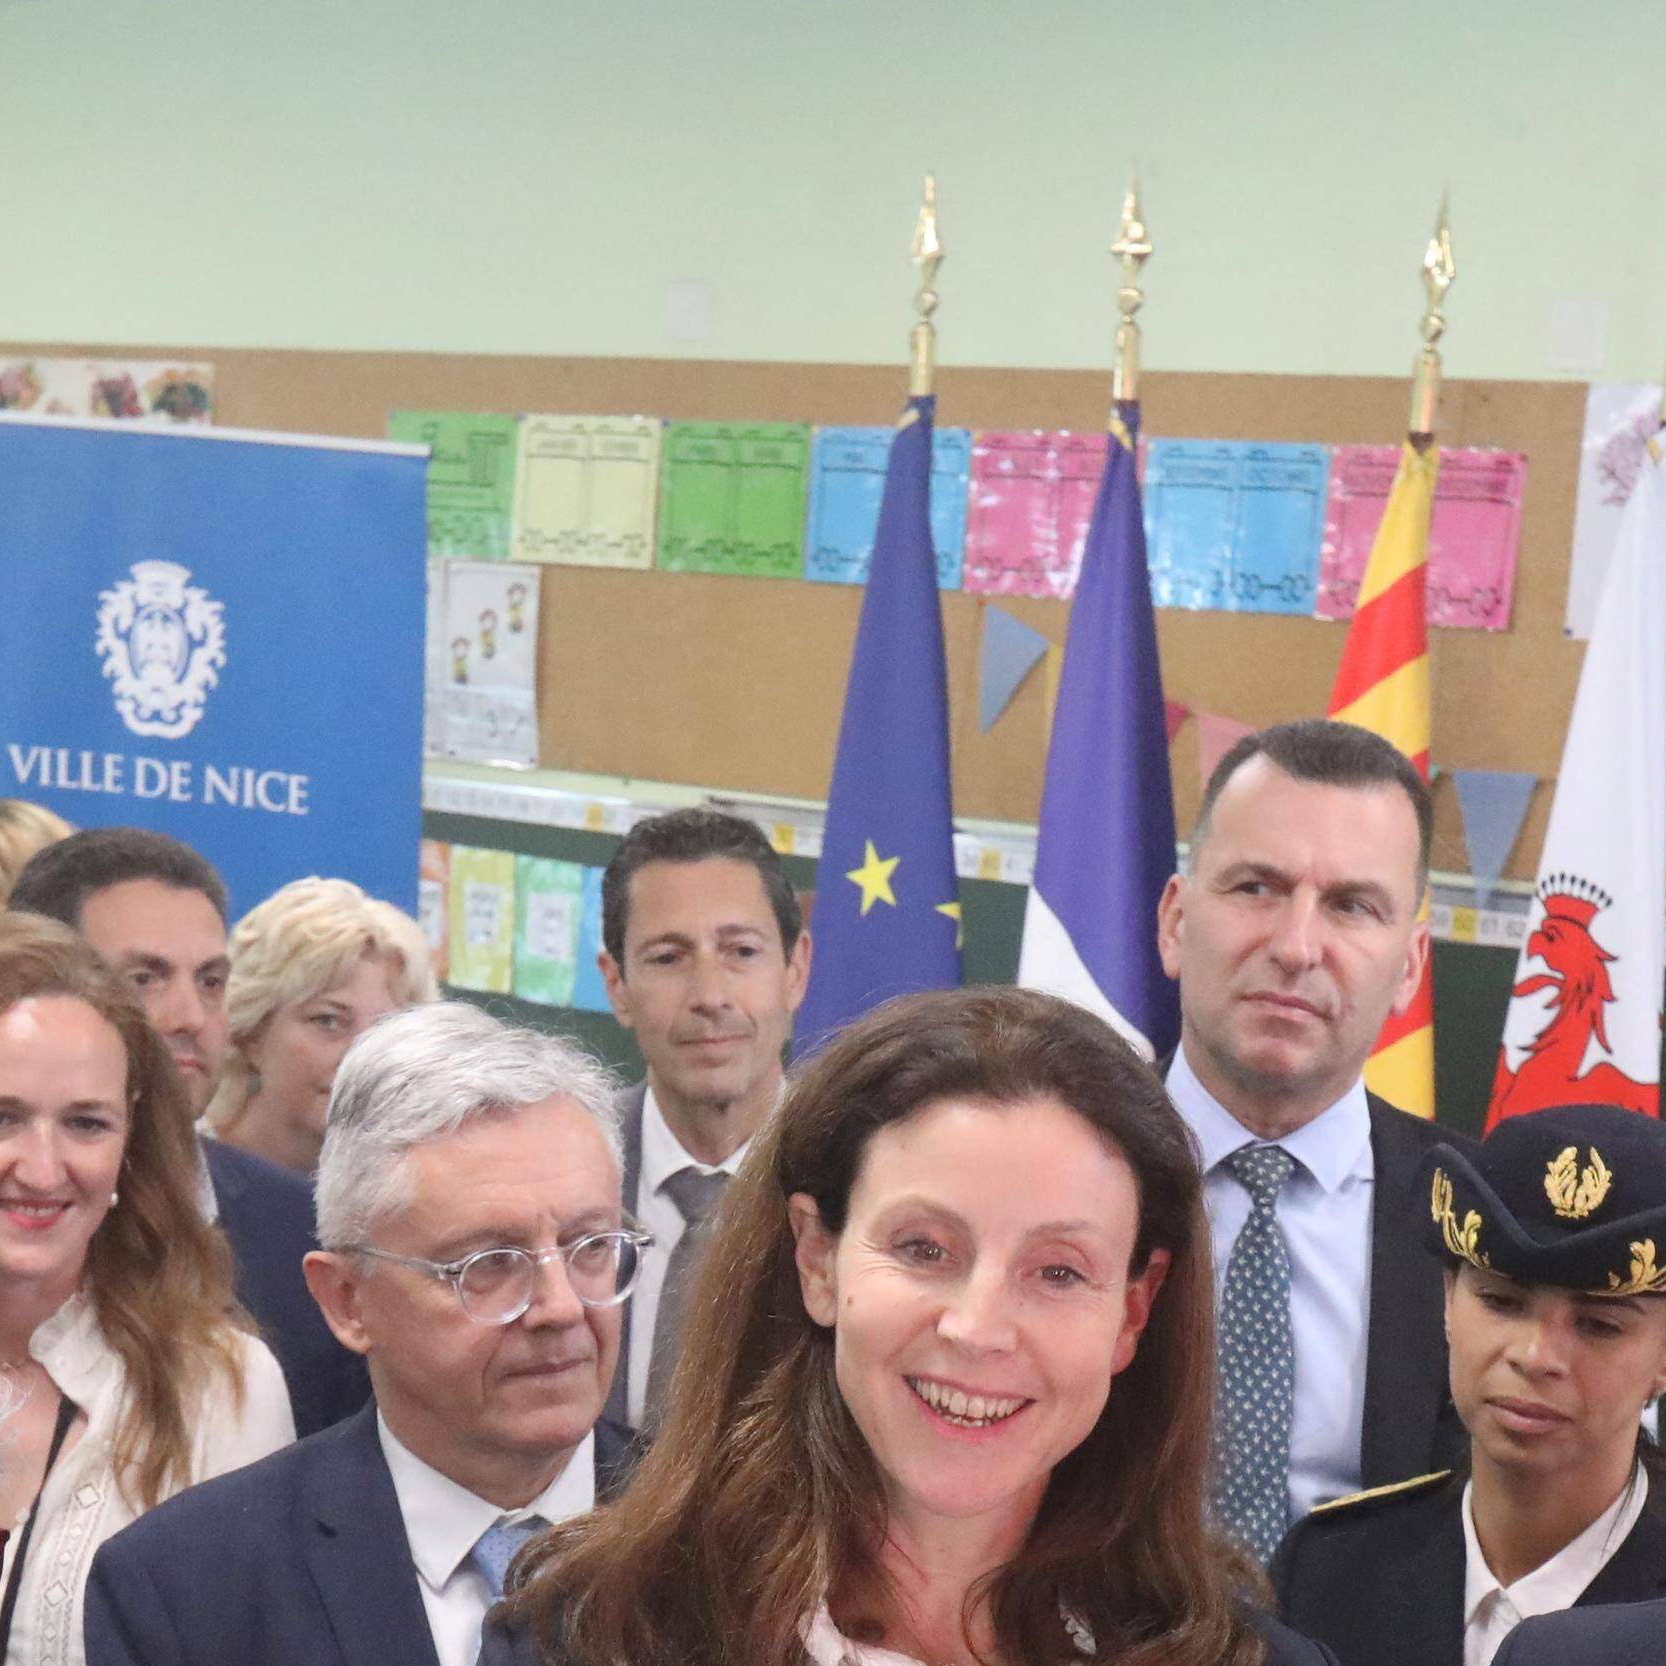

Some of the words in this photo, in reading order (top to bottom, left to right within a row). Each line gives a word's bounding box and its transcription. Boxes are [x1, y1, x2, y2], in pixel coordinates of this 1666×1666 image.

[8, 743, 125, 794] VILLE
[134, 756, 192, 802] DE
[204, 765, 309, 815] NICE
[1481, 916, 1498, 934] 61
[1505, 920, 1525, 937] 62
